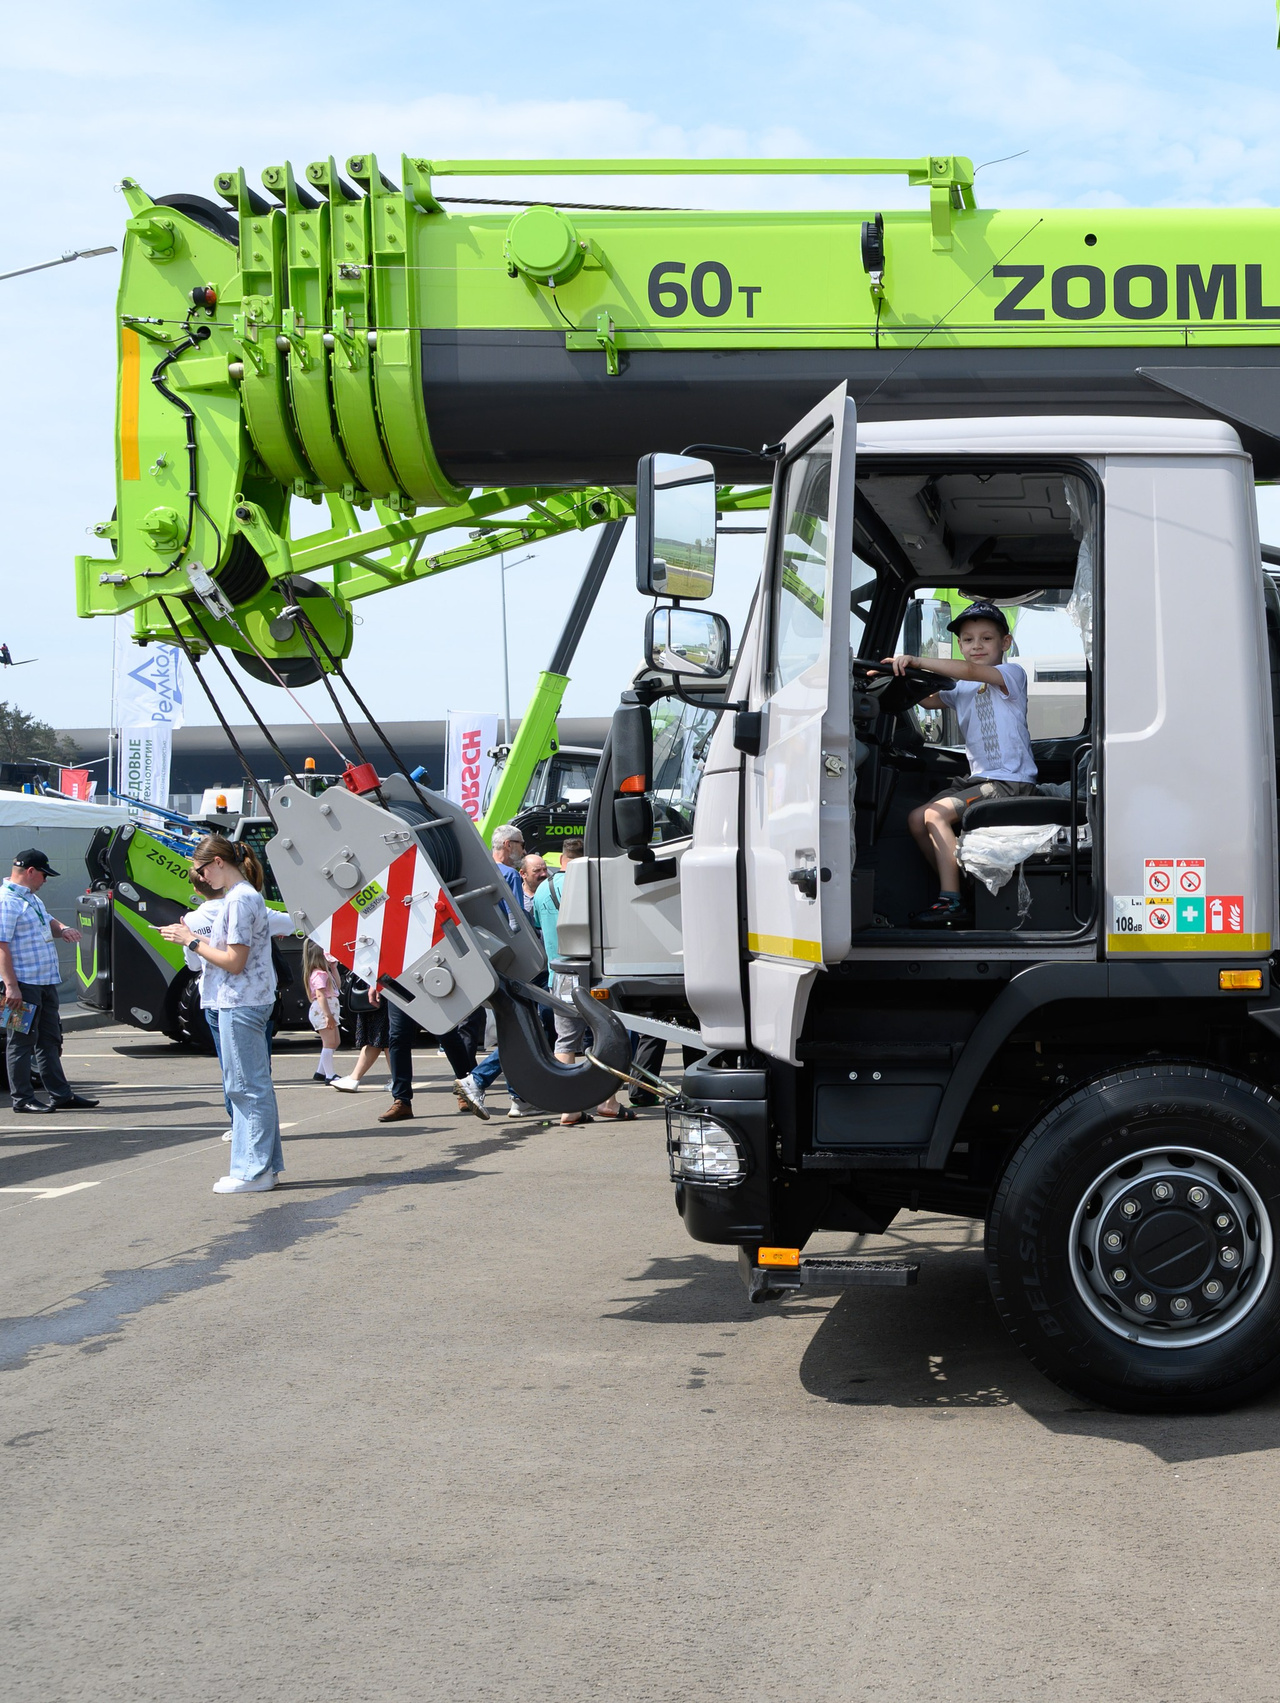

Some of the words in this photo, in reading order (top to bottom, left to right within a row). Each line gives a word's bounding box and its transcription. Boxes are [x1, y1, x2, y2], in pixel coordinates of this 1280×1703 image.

[128, 739, 142, 819] ЕЕДОВЫЕ
[545, 825, 586, 836] ZOOM
[146, 848, 193, 884] ZS120
[356, 886, 379, 906] 60t
[194, 926, 212, 935] OUB
[1018, 1136, 1077, 1337] BELSHINA
